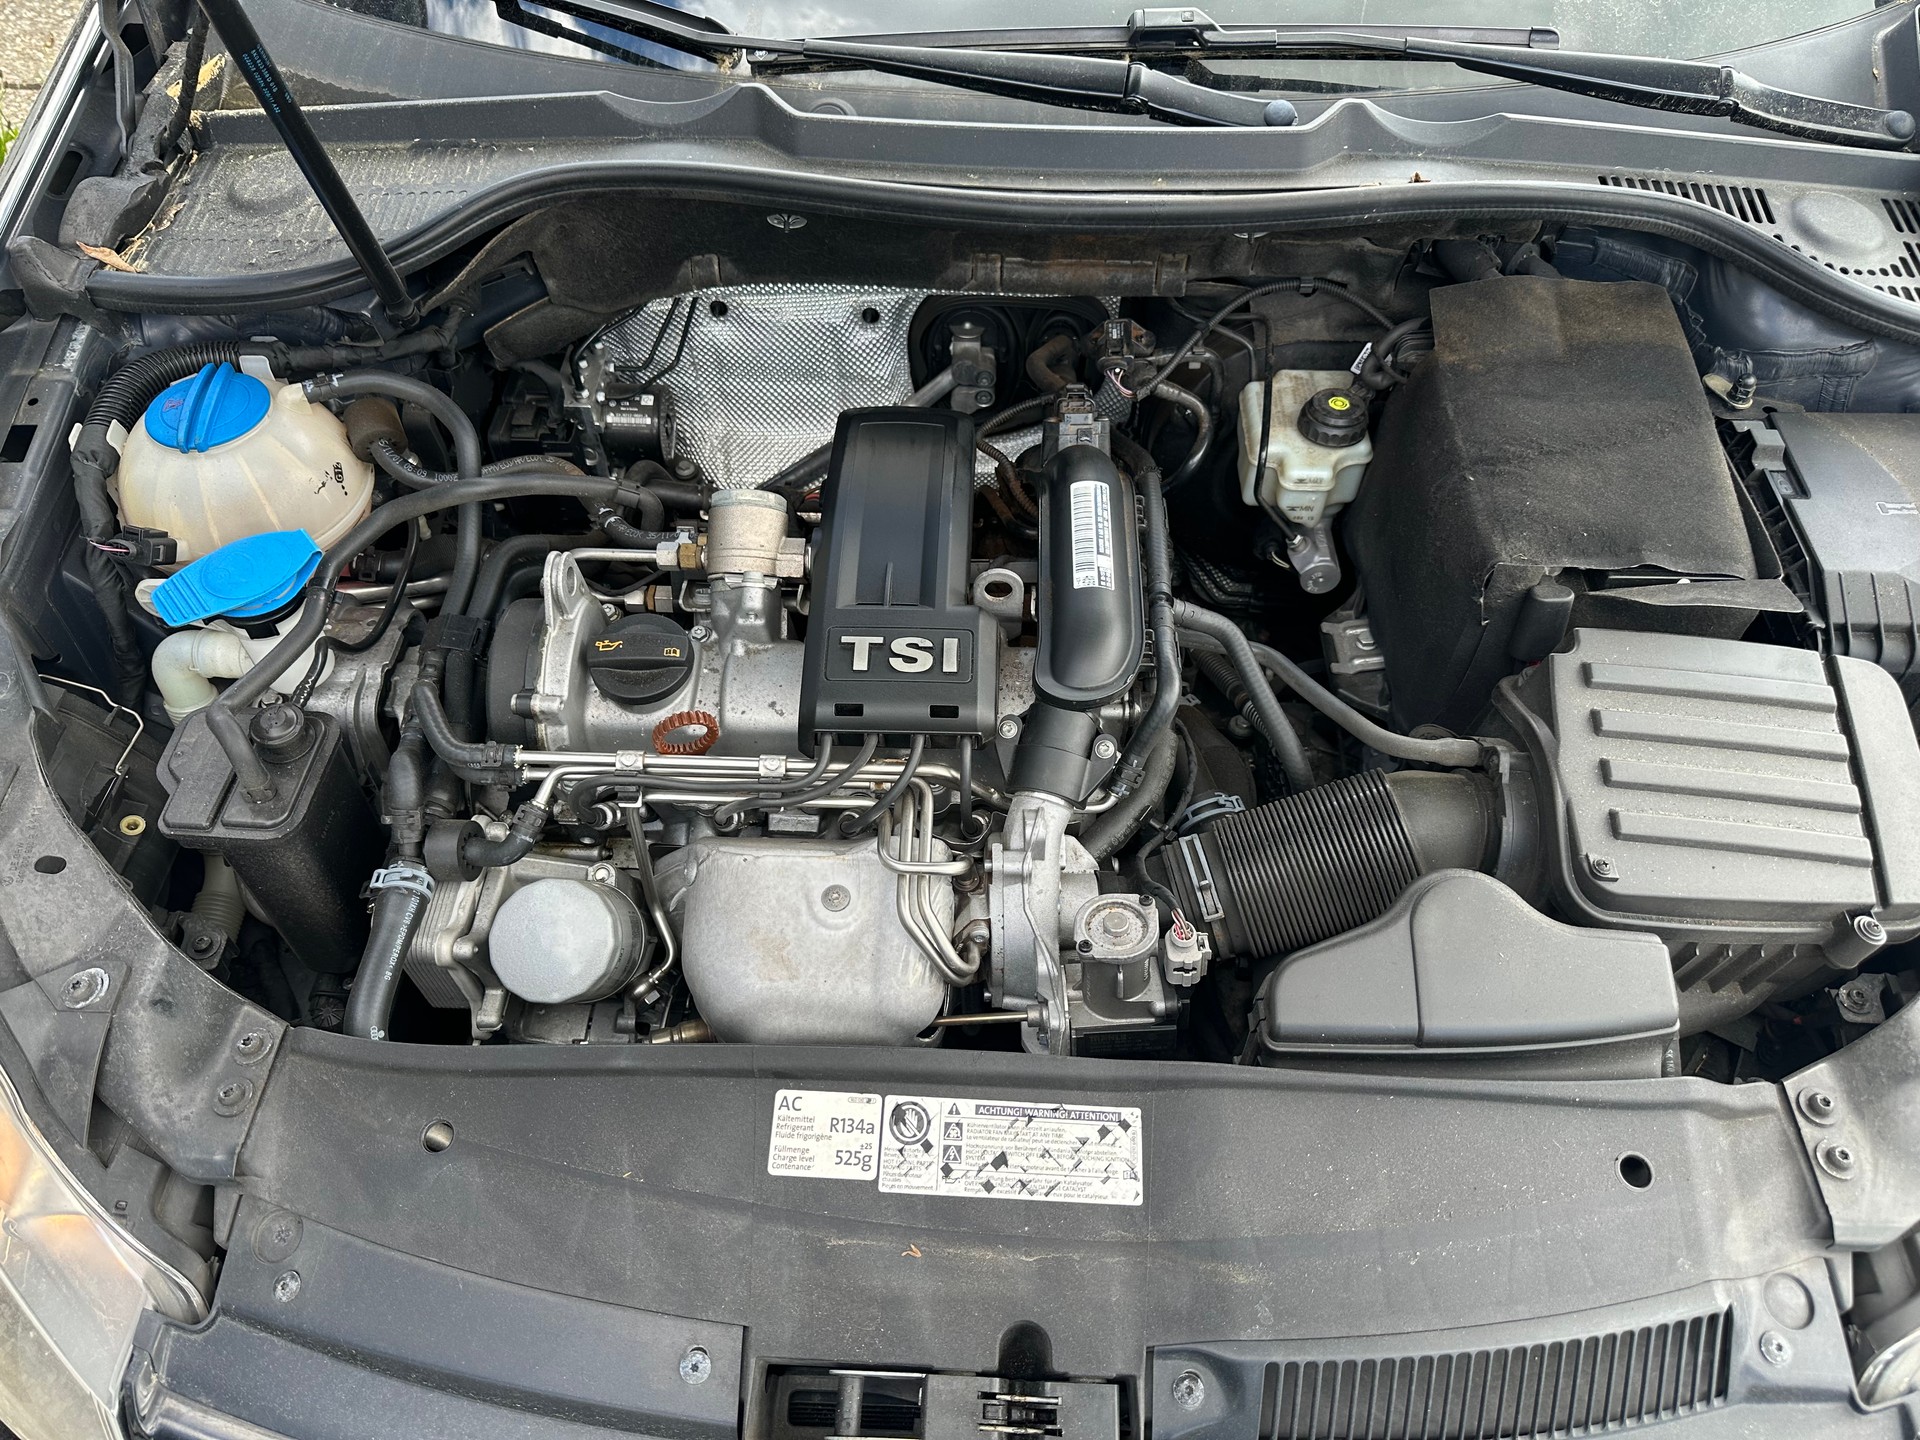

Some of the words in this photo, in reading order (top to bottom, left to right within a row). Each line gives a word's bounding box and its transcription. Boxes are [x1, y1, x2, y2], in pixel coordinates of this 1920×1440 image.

[841, 636, 959, 673] TSI
[778, 1096, 803, 1111] AC
[778, 1115, 815, 1123] Kältemittel
[979, 1107, 1022, 1116] ACHTUNG!
[1025, 1108, 1068, 1118] WARNING!
[1070, 1110, 1119, 1122] ATTENTION!
[776, 1123, 814, 1132] Refrigerant
[830, 1118, 874, 1134] R134a
[776, 1131, 795, 1139] Fluide
[797, 1133, 832, 1142] frigorigène
[774, 1146, 809, 1154] Füllmenge
[773, 1154, 797, 1162] Charge
[835, 1150, 872, 1171] 525g
[772, 1162, 811, 1170] Contenance
